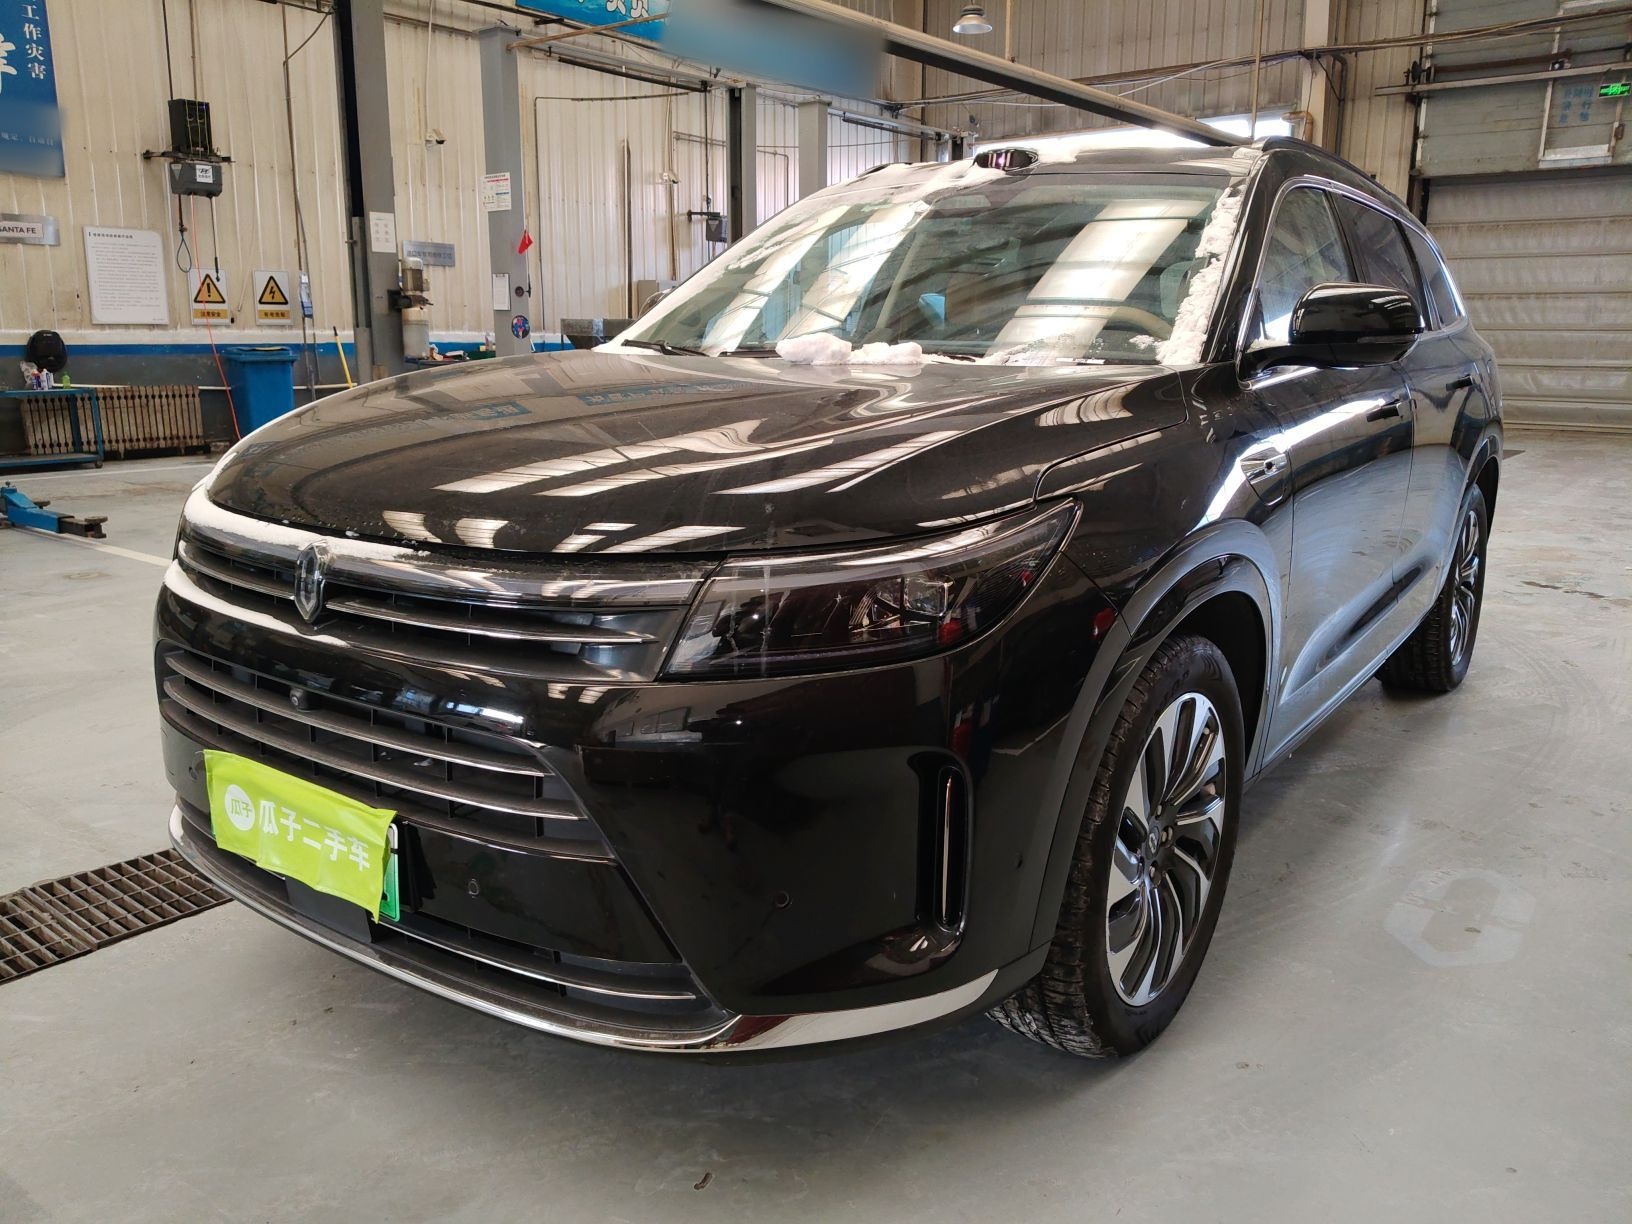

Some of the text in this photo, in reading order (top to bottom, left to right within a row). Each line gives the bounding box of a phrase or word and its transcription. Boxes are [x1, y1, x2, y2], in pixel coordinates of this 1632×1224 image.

[21, 4, 46, 79] 工作灾害
[230, 798, 252, 818] 瓜子
[259, 800, 371, 871] 瓜子二手车
